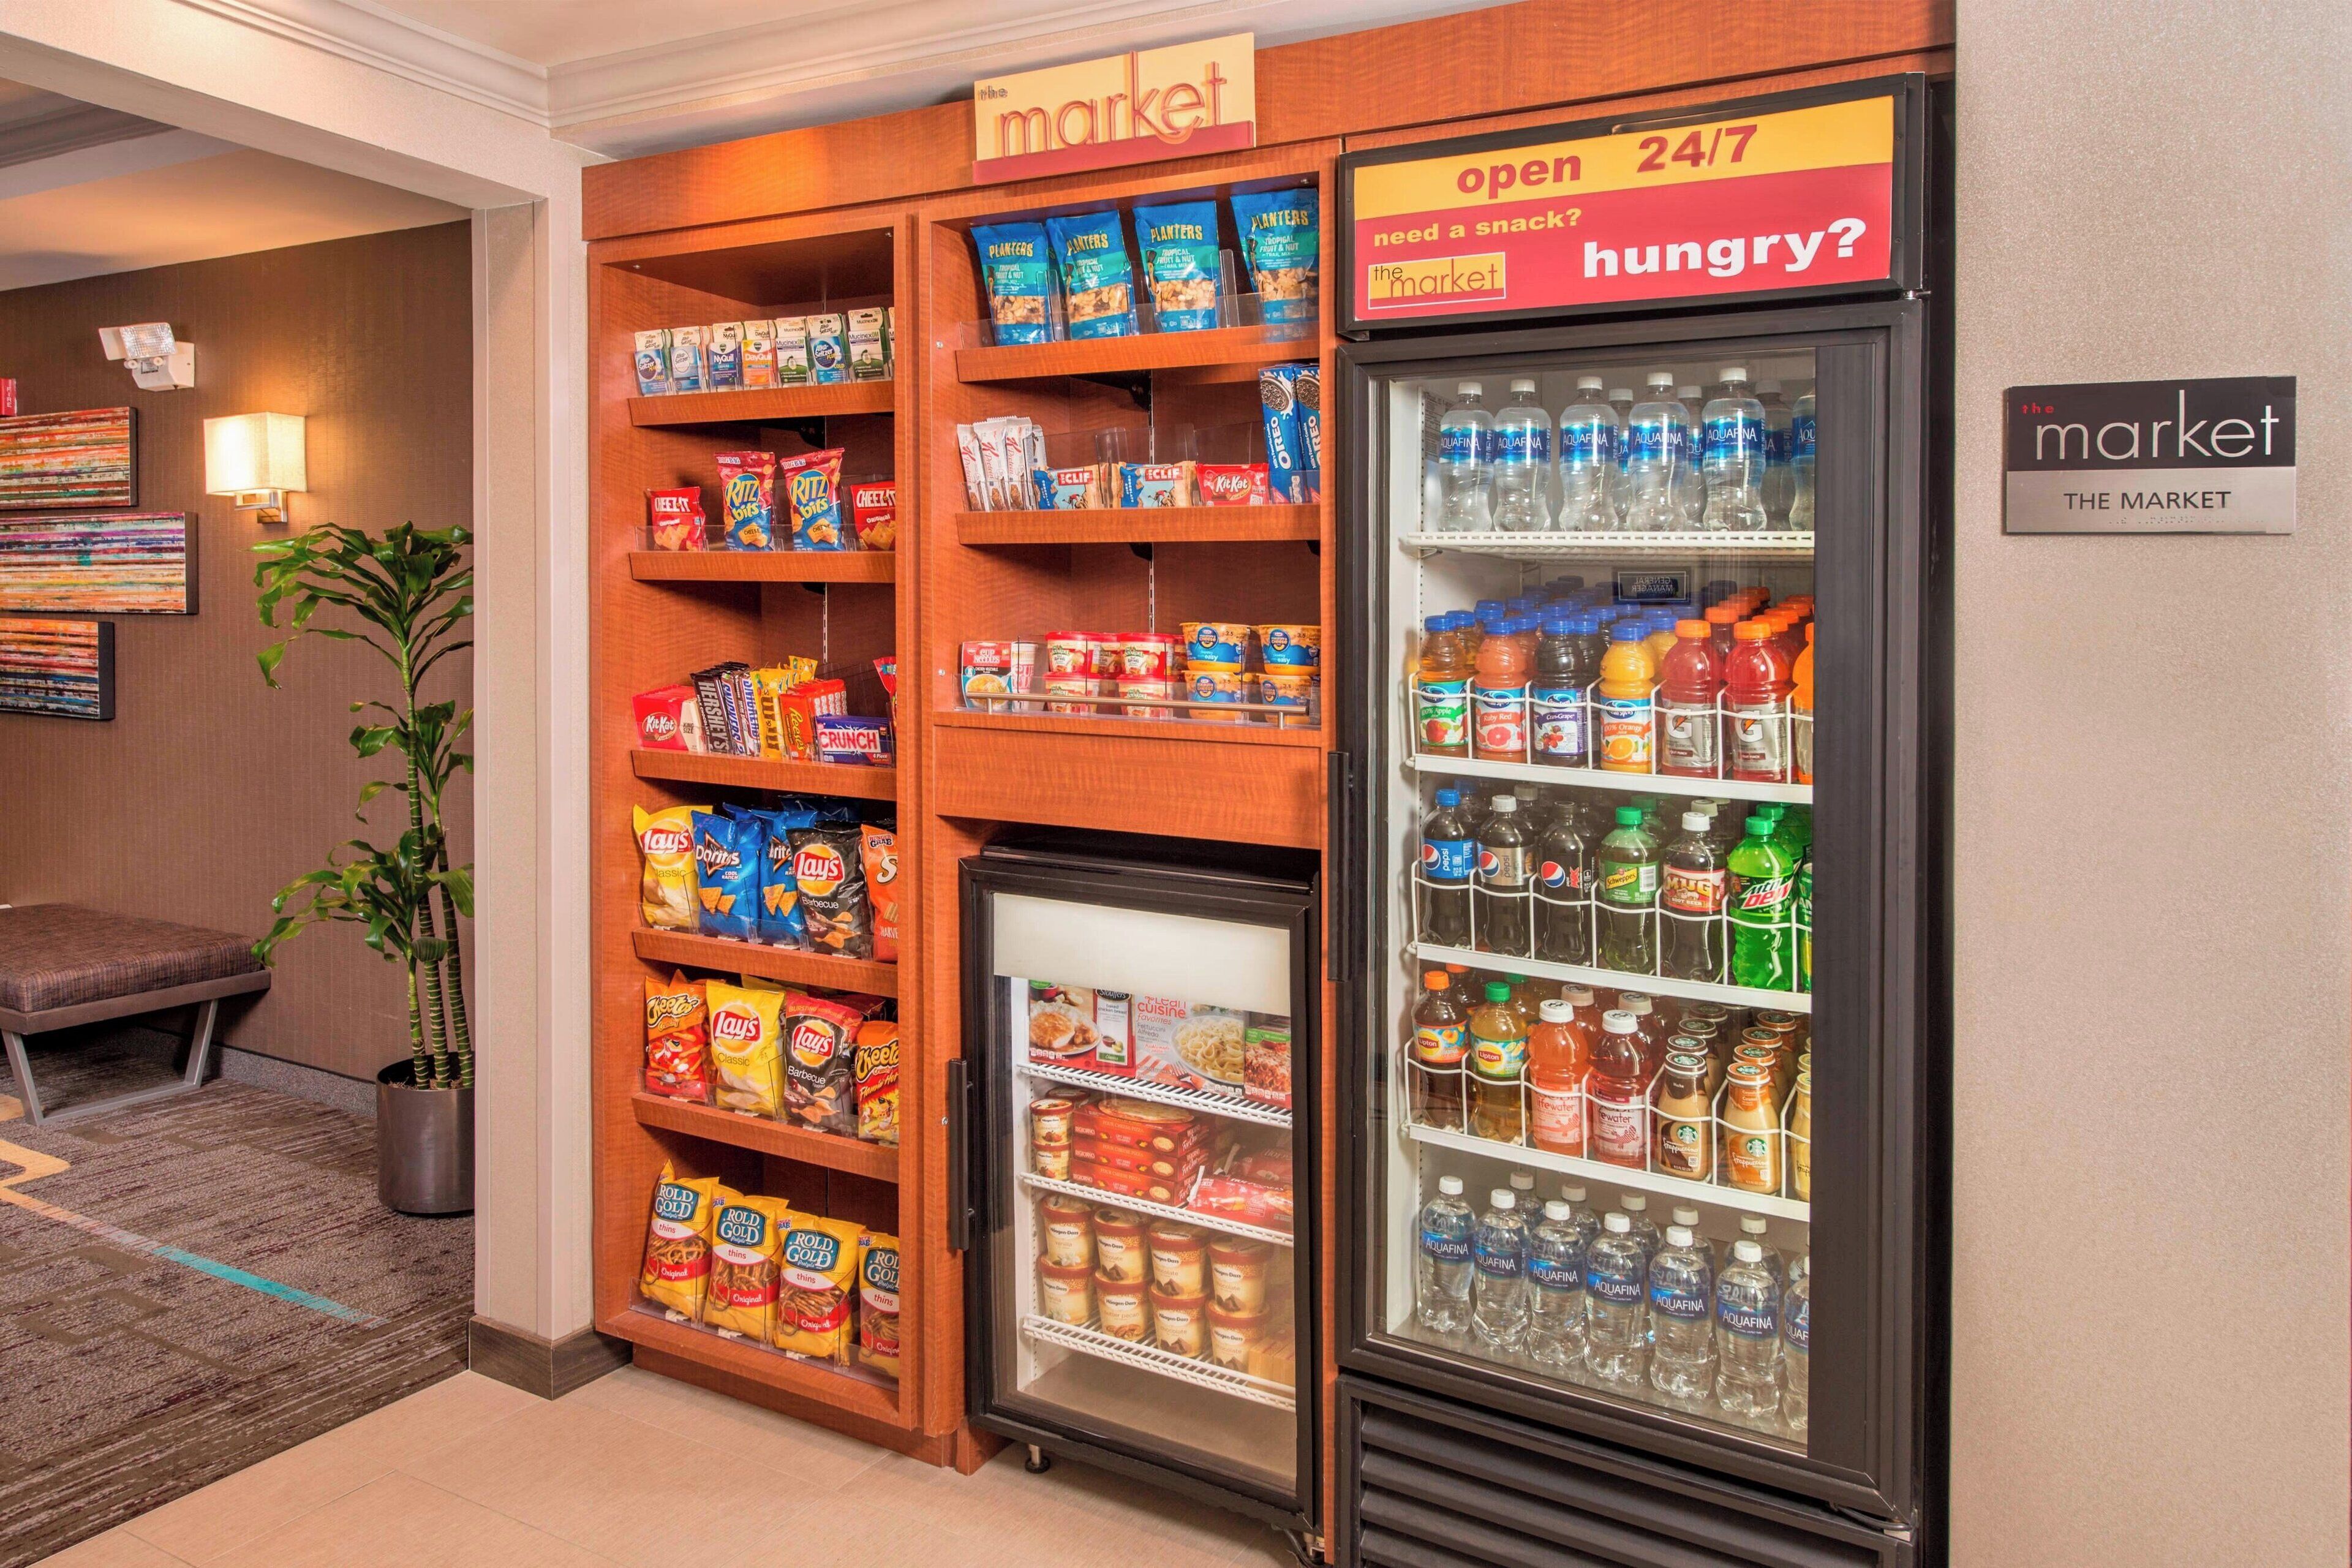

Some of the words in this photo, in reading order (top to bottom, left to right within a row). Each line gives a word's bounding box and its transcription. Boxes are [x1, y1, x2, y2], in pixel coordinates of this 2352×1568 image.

[979, 85, 1008, 100] the
[1001, 51, 1227, 157] market
[1457, 153, 1581, 199] open
[1637, 125, 1758, 173] 24/7
[1252, 209, 1309, 230] PLANTERS
[1374, 223, 1439, 247] need
[1449, 223, 1466, 239] a
[1476, 208, 1582, 236] snack?
[1150, 224, 1203, 243] PLANTERS
[1265, 235, 1294, 245] TROPICAL
[989, 242, 1033, 259] PLANTERS
[1066, 234, 1109, 257] PLANTERS
[1161, 248, 1189, 257] TROPICAL
[1285, 243, 1298, 251] NUT
[1585, 217, 1867, 278] hungry?
[1182, 254, 1194, 263] NUT
[1374, 264, 1403, 281] the
[1390, 258, 1498, 298] market
[714, 355, 734, 364] NyQuil
[745, 353, 772, 363] DayQuil
[2022, 403, 2054, 414] the
[2037, 390, 2279, 460] market
[1271, 417, 1292, 470] OREO
[1065, 472, 1091, 483] CLIF
[1152, 467, 1180, 479] CLIF
[727, 478, 760, 506] RITZ
[793, 476, 827, 505] RITZ
[1216, 476, 1248, 492] KitKat
[800, 499, 829, 519] bits
[2064, 492, 2110, 510] THE
[2120, 491, 2231, 510] MARKET
[732, 503, 760, 522] bits
[645, 715, 674, 731] KitKat
[1619, 723, 1643, 733] Orange
[1666, 709, 1693, 739] G
[1735, 710, 1763, 743] G
[818, 731, 878, 750] CRUNCH
[644, 829, 690, 854] Lay's
[696, 844, 741, 865] Doritos
[1441, 848, 1451, 871] pepsi
[797, 858, 842, 881] Lay's
[1607, 873, 1636, 886] Schweppes
[1667, 876, 1711, 897] MUG
[802, 896, 839, 910] Barbecue
[715, 1011, 758, 1040] Lay's
[1137, 1013, 1172, 1025] favorites
[1137, 1023, 1166, 1033] Fettuccini
[796, 1026, 832, 1054] Lay's
[1137, 1029, 1159, 1038] Alfredo
[1419, 1038, 1437, 1047] Lipton
[718, 1053, 750, 1067] Classic
[1480, 1052, 1499, 1060] Lipton
[788, 1065, 826, 1085] Barbecue
[1663, 1137, 1698, 1154] frappuccino
[1112, 1170, 1128, 1179] CHEESE
[660, 1185, 693, 1203] ROLD
[655, 1197, 691, 1218] GOLD
[728, 1208, 760, 1227] ROLD
[659, 1223, 676, 1234] thins
[720, 1221, 759, 1243] GOLD
[796, 1232, 833, 1253] ROLD
[1425, 1237, 1469, 1255] AQUAFINA
[728, 1249, 747, 1259] thins
[786, 1248, 832, 1268] GOLD
[875, 1250, 899, 1270] ROL
[661, 1268, 688, 1278] Original
[796, 1273, 815, 1284] thins
[867, 1264, 899, 1286] GOL
[1532, 1265, 1579, 1283] AQUAFINA
[1594, 1279, 1641, 1296] AQUAFINA
[733, 1293, 763, 1303] Original
[875, 1294, 894, 1306] thins
[1656, 1294, 1705, 1312] AQUAFINA
[1722, 1310, 1773, 1330] AQUAFINA
